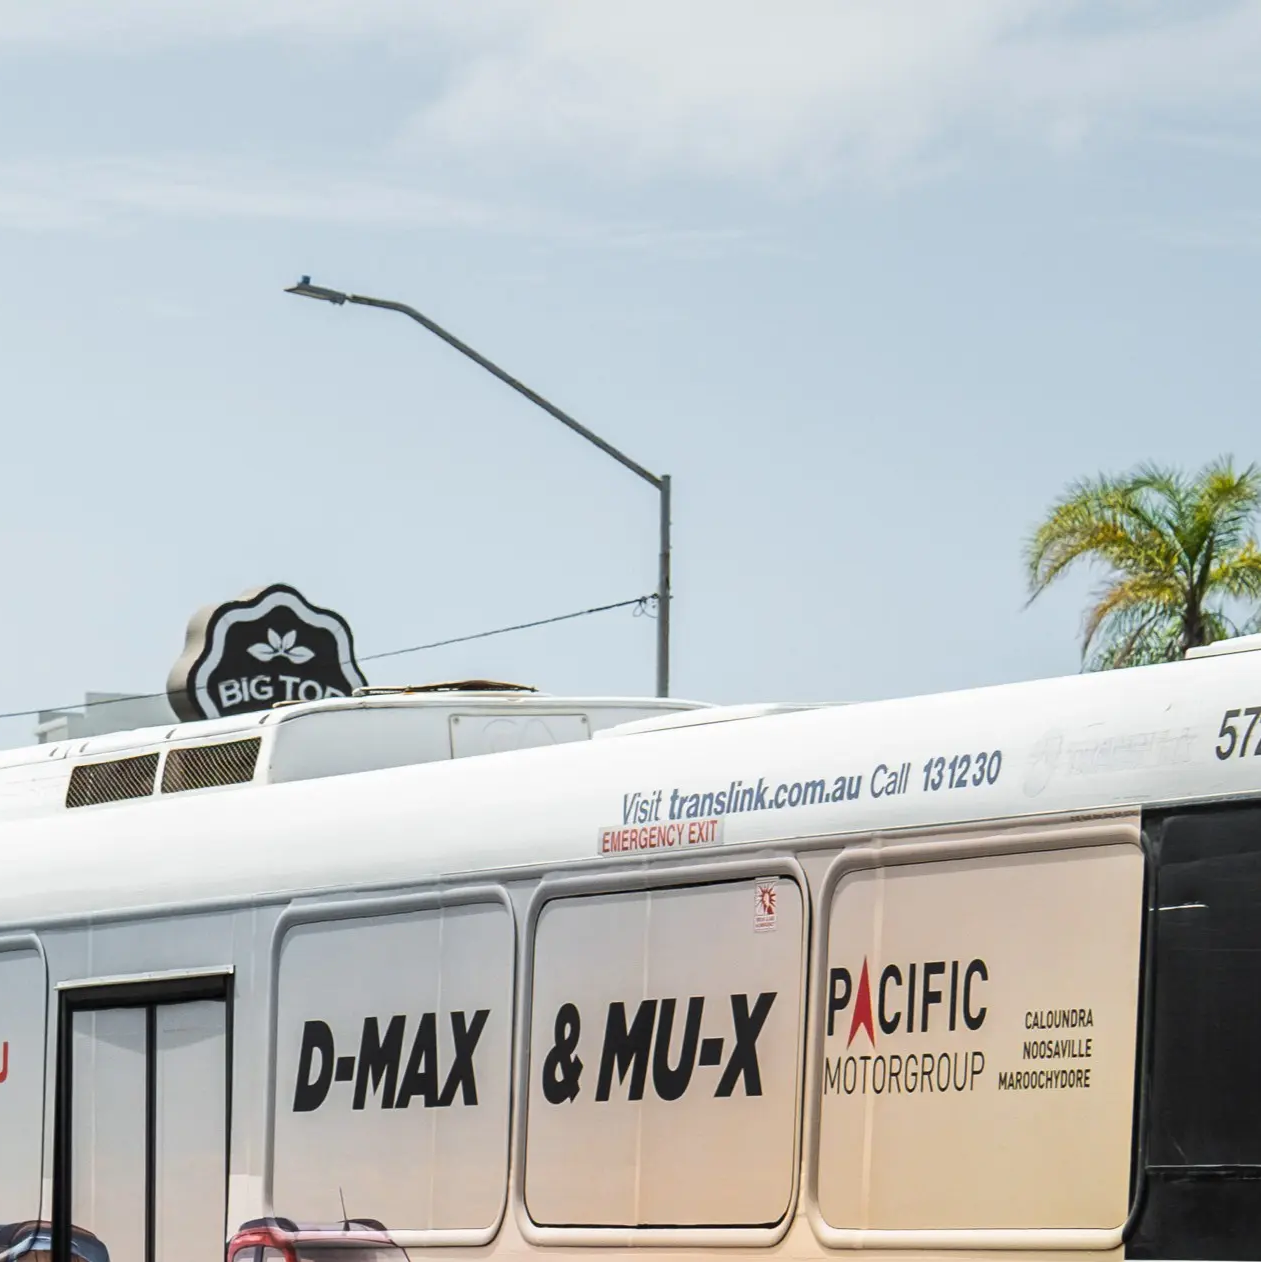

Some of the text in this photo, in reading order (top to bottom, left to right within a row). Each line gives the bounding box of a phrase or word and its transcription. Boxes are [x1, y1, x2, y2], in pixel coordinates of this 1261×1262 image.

[218, 675, 274, 709] BIG
[1215, 706, 1261, 761] 57
[623, 790, 663, 825] Visit
[669, 774, 863, 819] translink.com.au
[870, 762, 912, 799] Call
[601, 819, 719, 854] EMERGENCY EXIT
[826, 955, 989, 1051] PACIFIC
[1024, 1008, 1094, 1030] CALOUNDRA
[292, 992, 778, 1112] D-MAX & MU-X
[1023, 1038, 1092, 1060] NOOSAVILLE
[823, 1051, 986, 1096] MOTORGROUP
[998, 1068, 1091, 1091] MAROOCHYDORE
